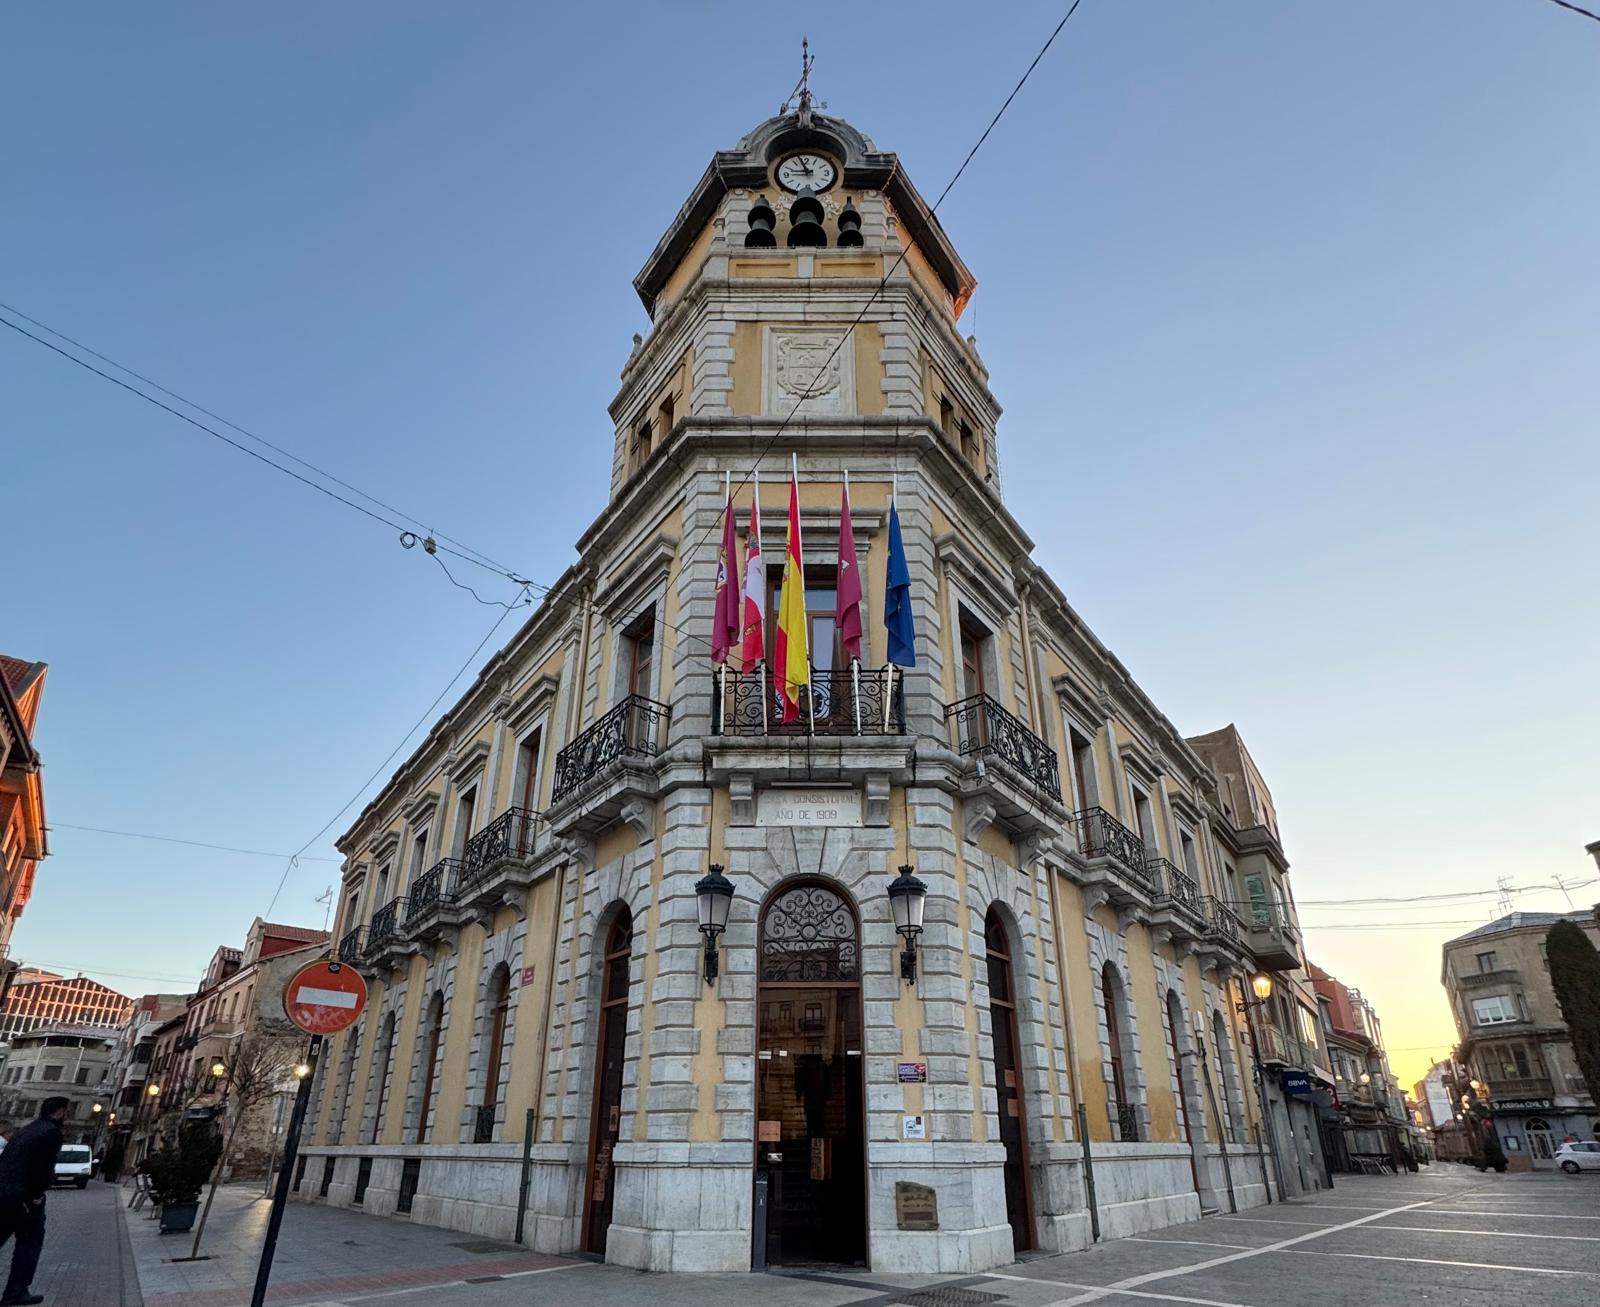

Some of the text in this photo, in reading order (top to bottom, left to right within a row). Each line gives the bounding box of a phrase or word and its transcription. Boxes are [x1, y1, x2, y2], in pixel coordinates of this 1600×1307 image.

[824, 169, 830, 177] 3
[775, 807, 838, 820] AÑO DE 1909
[1287, 1079, 1308, 1087] BBVA
